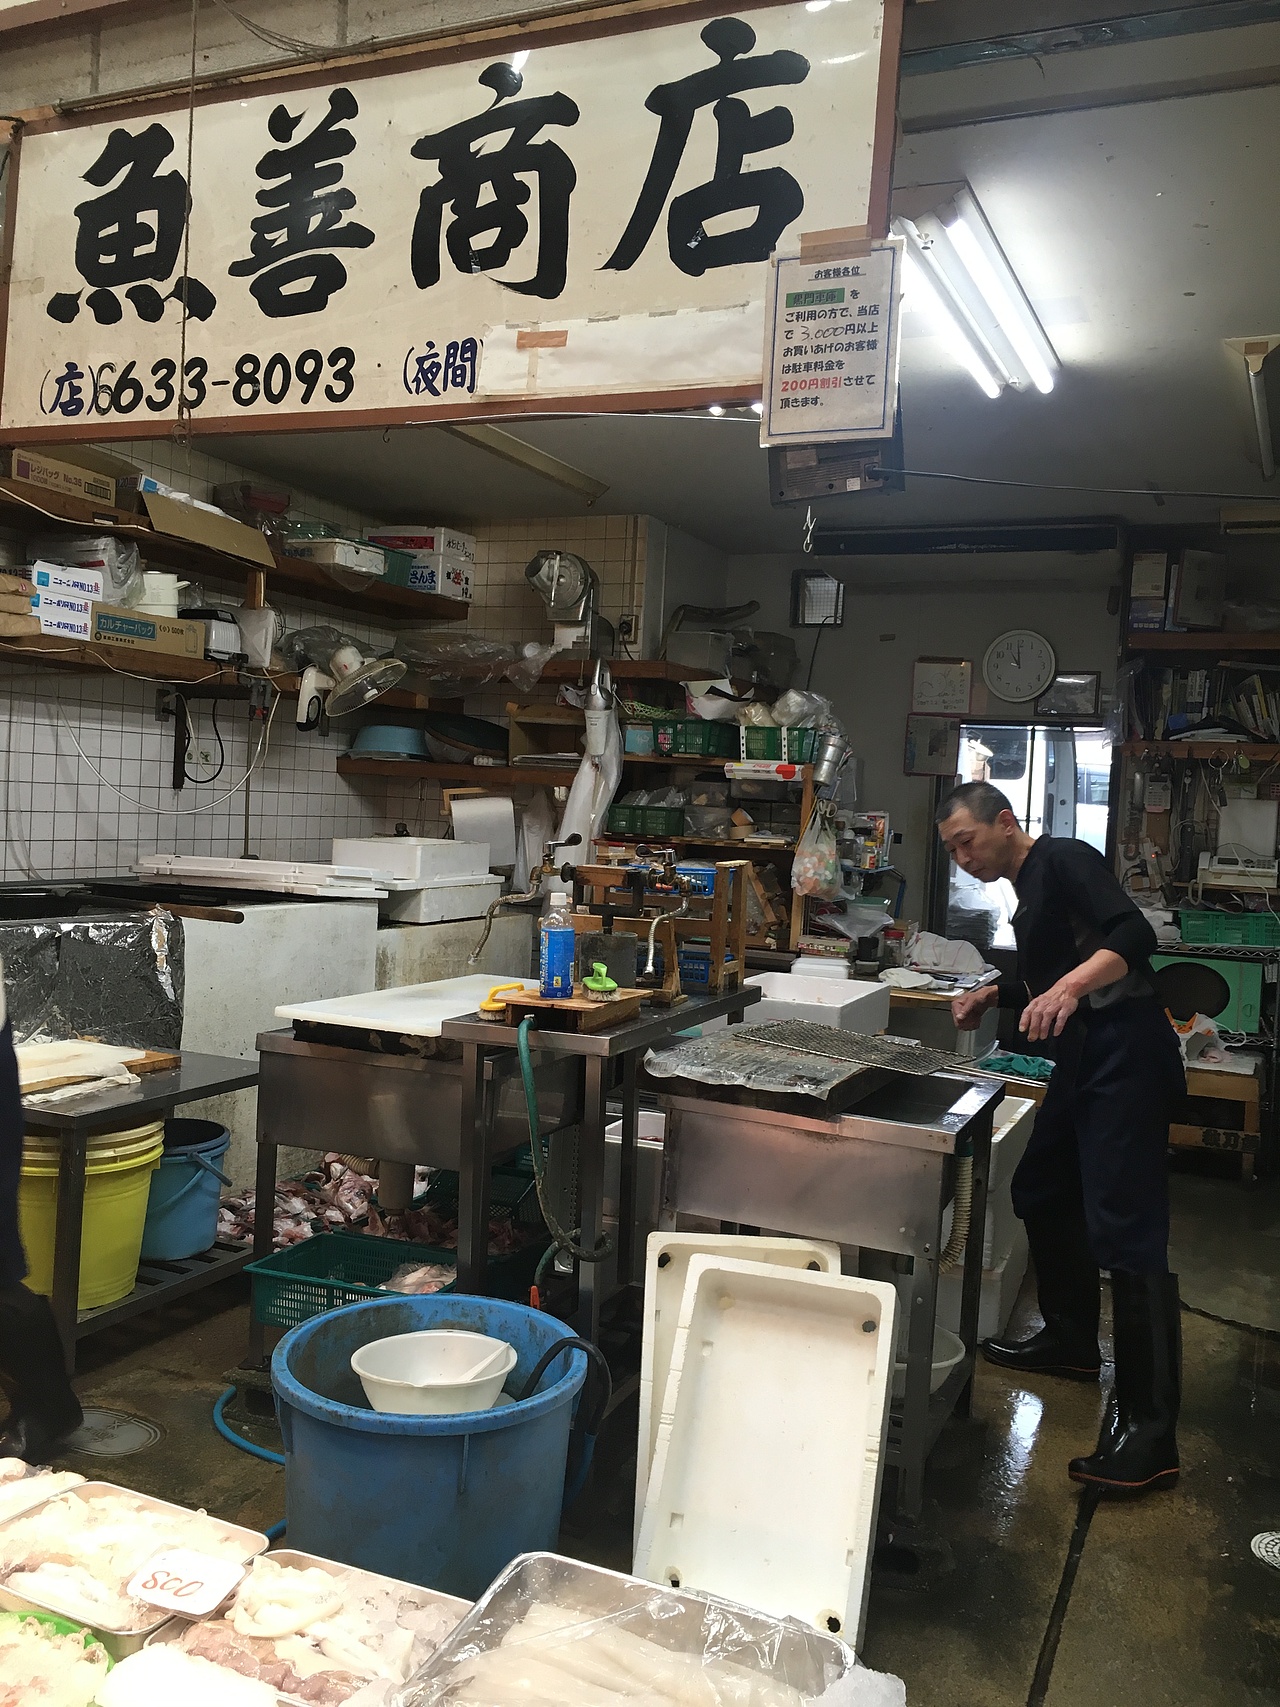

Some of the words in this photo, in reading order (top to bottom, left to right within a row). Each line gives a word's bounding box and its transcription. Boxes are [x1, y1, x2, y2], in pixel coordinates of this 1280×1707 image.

[46, 17, 810, 325] 魚善商店
[813, 265, 861, 279] お客様各位
[849, 289, 860, 299] を
[785, 304, 880, 323] ご利用の方で、当店
[783, 339, 878, 357] お買いあげのお客様
[403, 338, 484, 397] (夜間
[781, 360, 845, 375] は駐車料金を
[780, 396, 825, 409] 頂きます。
[409, 569, 437, 585] さんま
[100, 618, 154, 636] カルチャーバッグ
